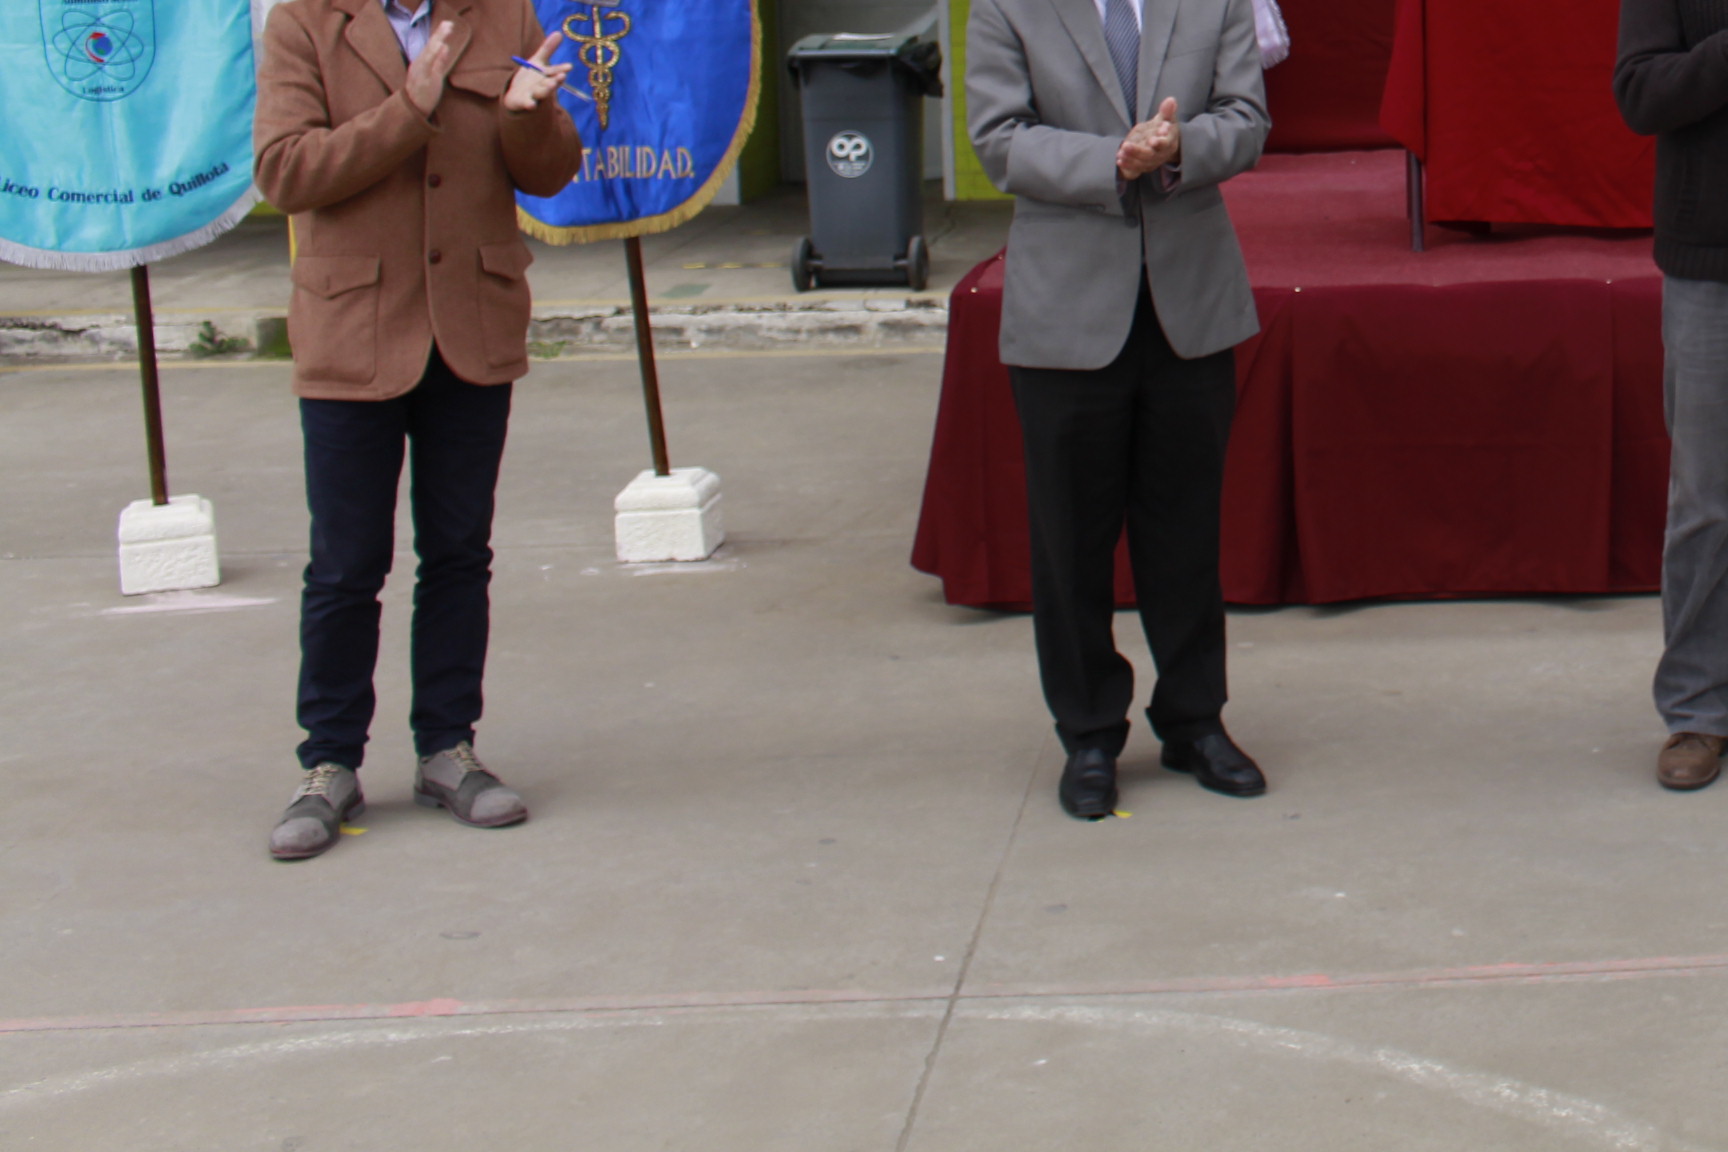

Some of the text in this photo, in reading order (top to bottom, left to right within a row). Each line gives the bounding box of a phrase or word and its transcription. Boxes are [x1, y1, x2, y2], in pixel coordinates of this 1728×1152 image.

[0, 162, 230, 204] iceo Comercial de Quillota
[573, 145, 695, 184] TABILIDAD.
